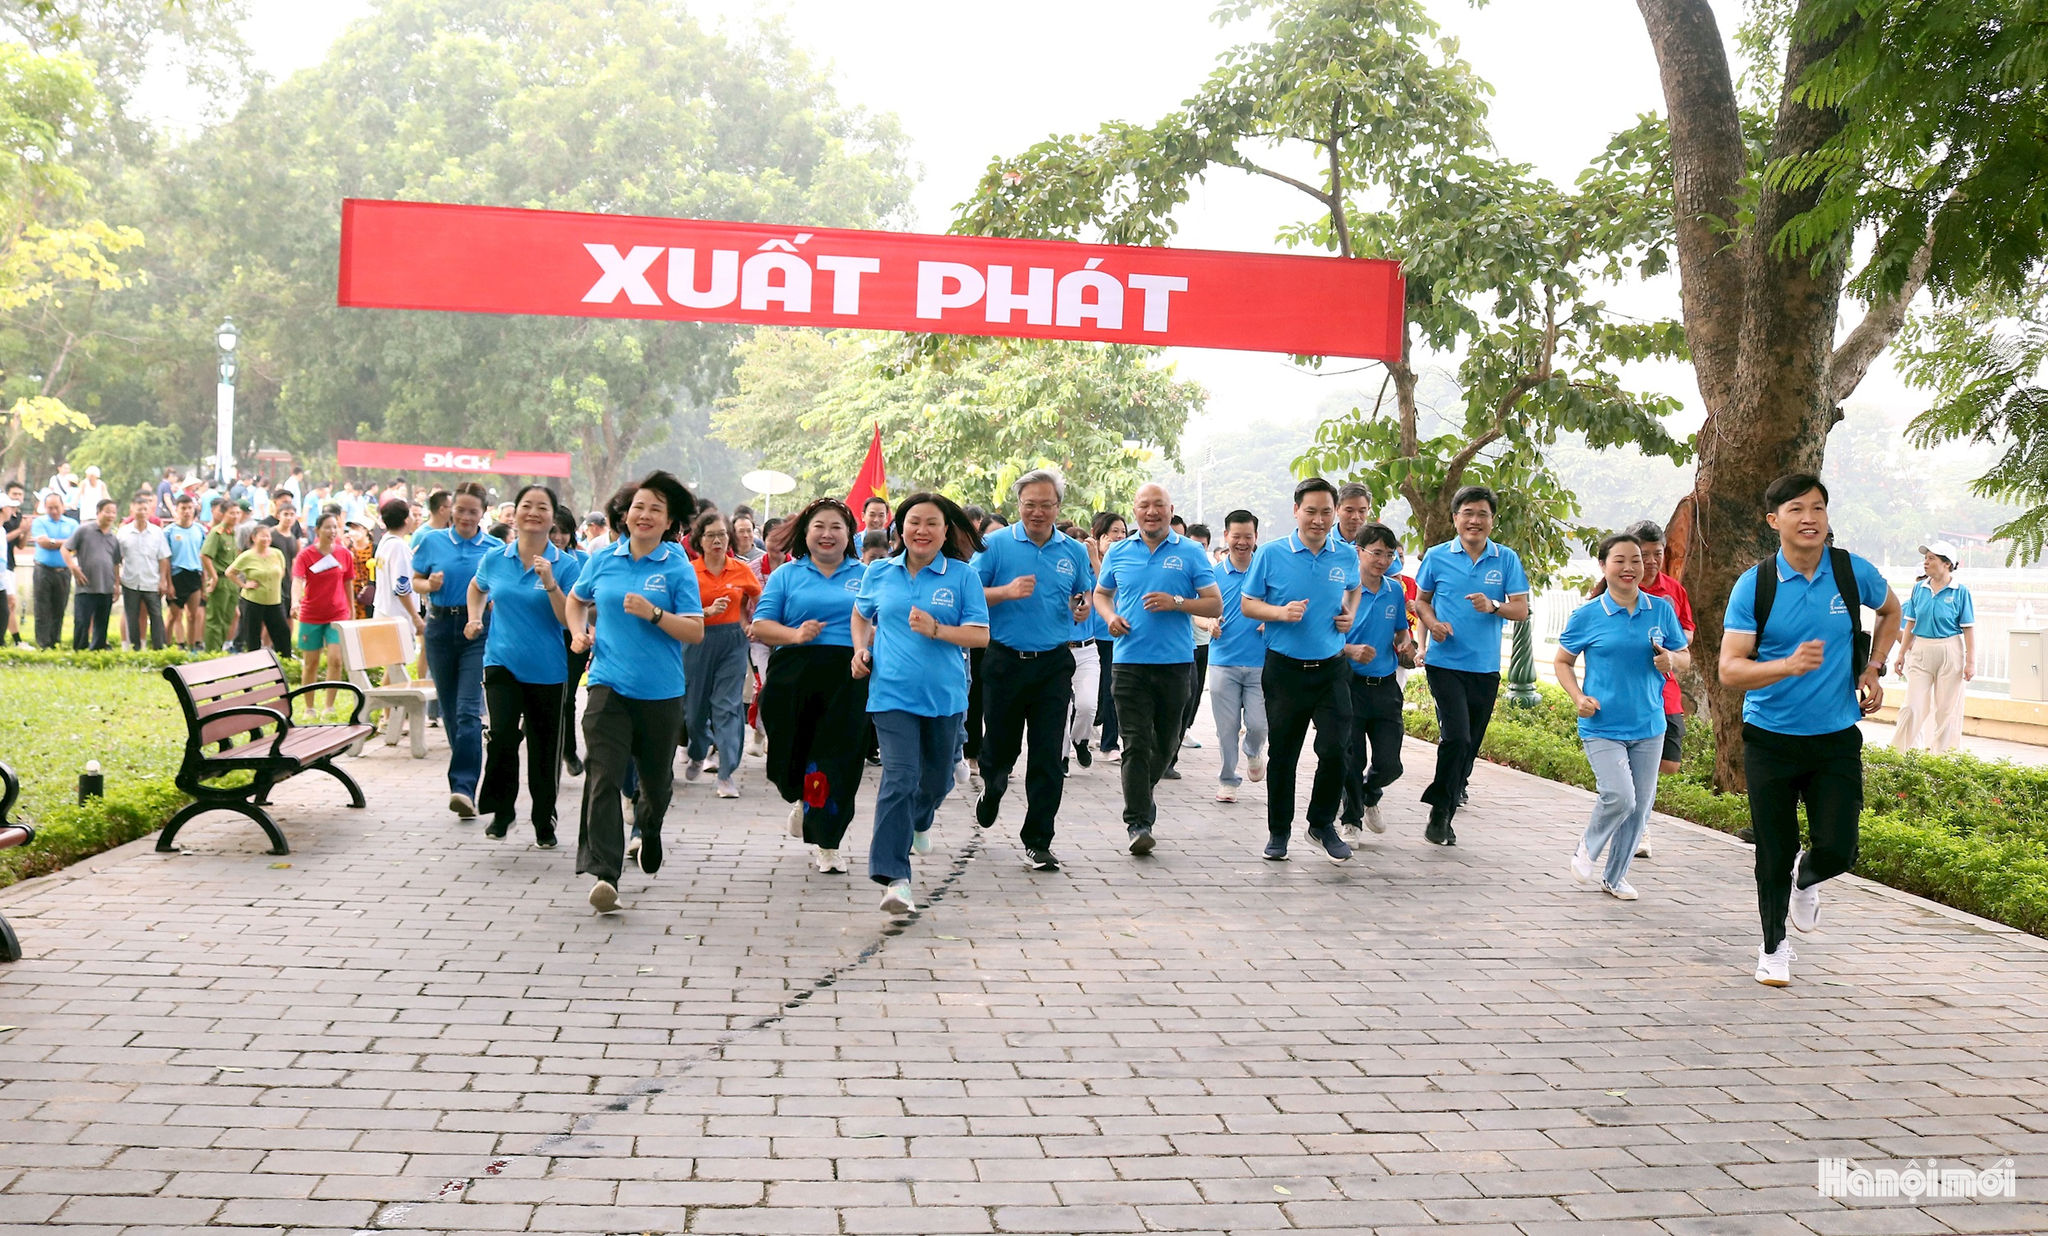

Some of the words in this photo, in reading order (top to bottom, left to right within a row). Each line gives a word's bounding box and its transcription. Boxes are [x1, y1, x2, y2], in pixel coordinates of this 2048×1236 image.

[581, 233, 880, 315] XUẤT
[916, 258, 1189, 333] PHÁT
[423, 451, 491, 470] ĐÍCH
